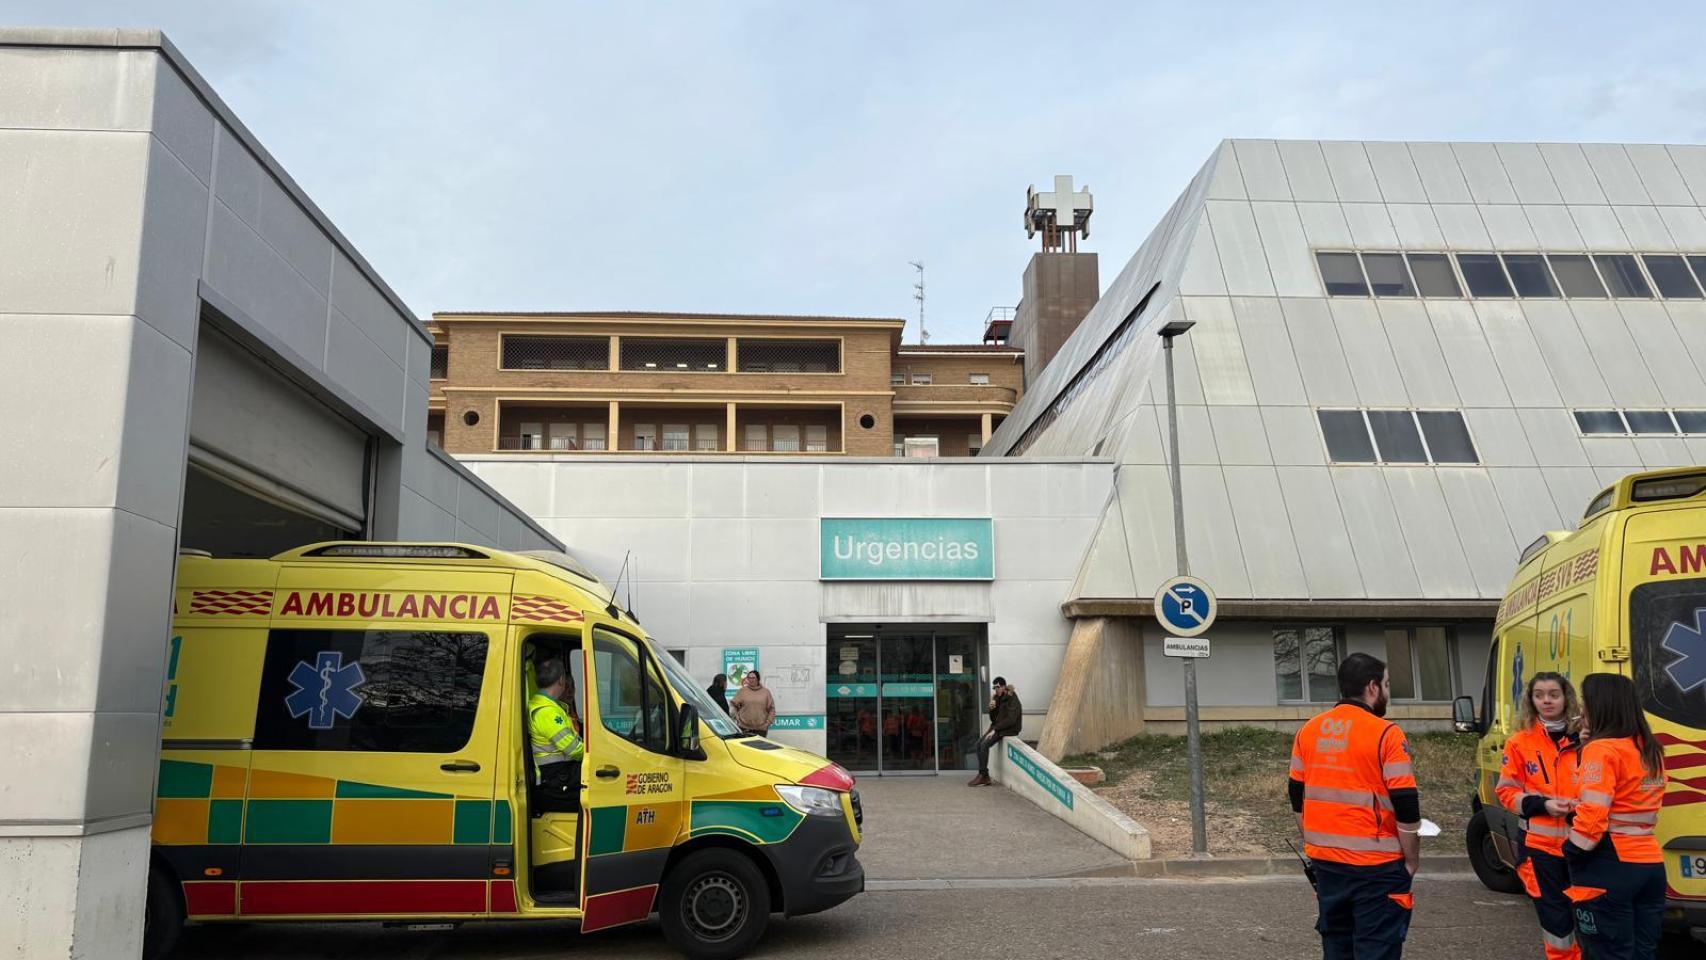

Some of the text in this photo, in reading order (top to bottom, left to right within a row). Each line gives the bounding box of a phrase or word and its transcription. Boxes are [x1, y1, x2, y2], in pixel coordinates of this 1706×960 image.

[834, 535, 979, 566] Urgencias
[280, 591, 501, 620] AMBULANCIA
[1550, 607, 1573, 661] 061
[1166, 643, 1209, 652] AMBULANCIAS
[639, 772, 669, 784] GOBIERNO
[637, 784, 646, 795] DE
